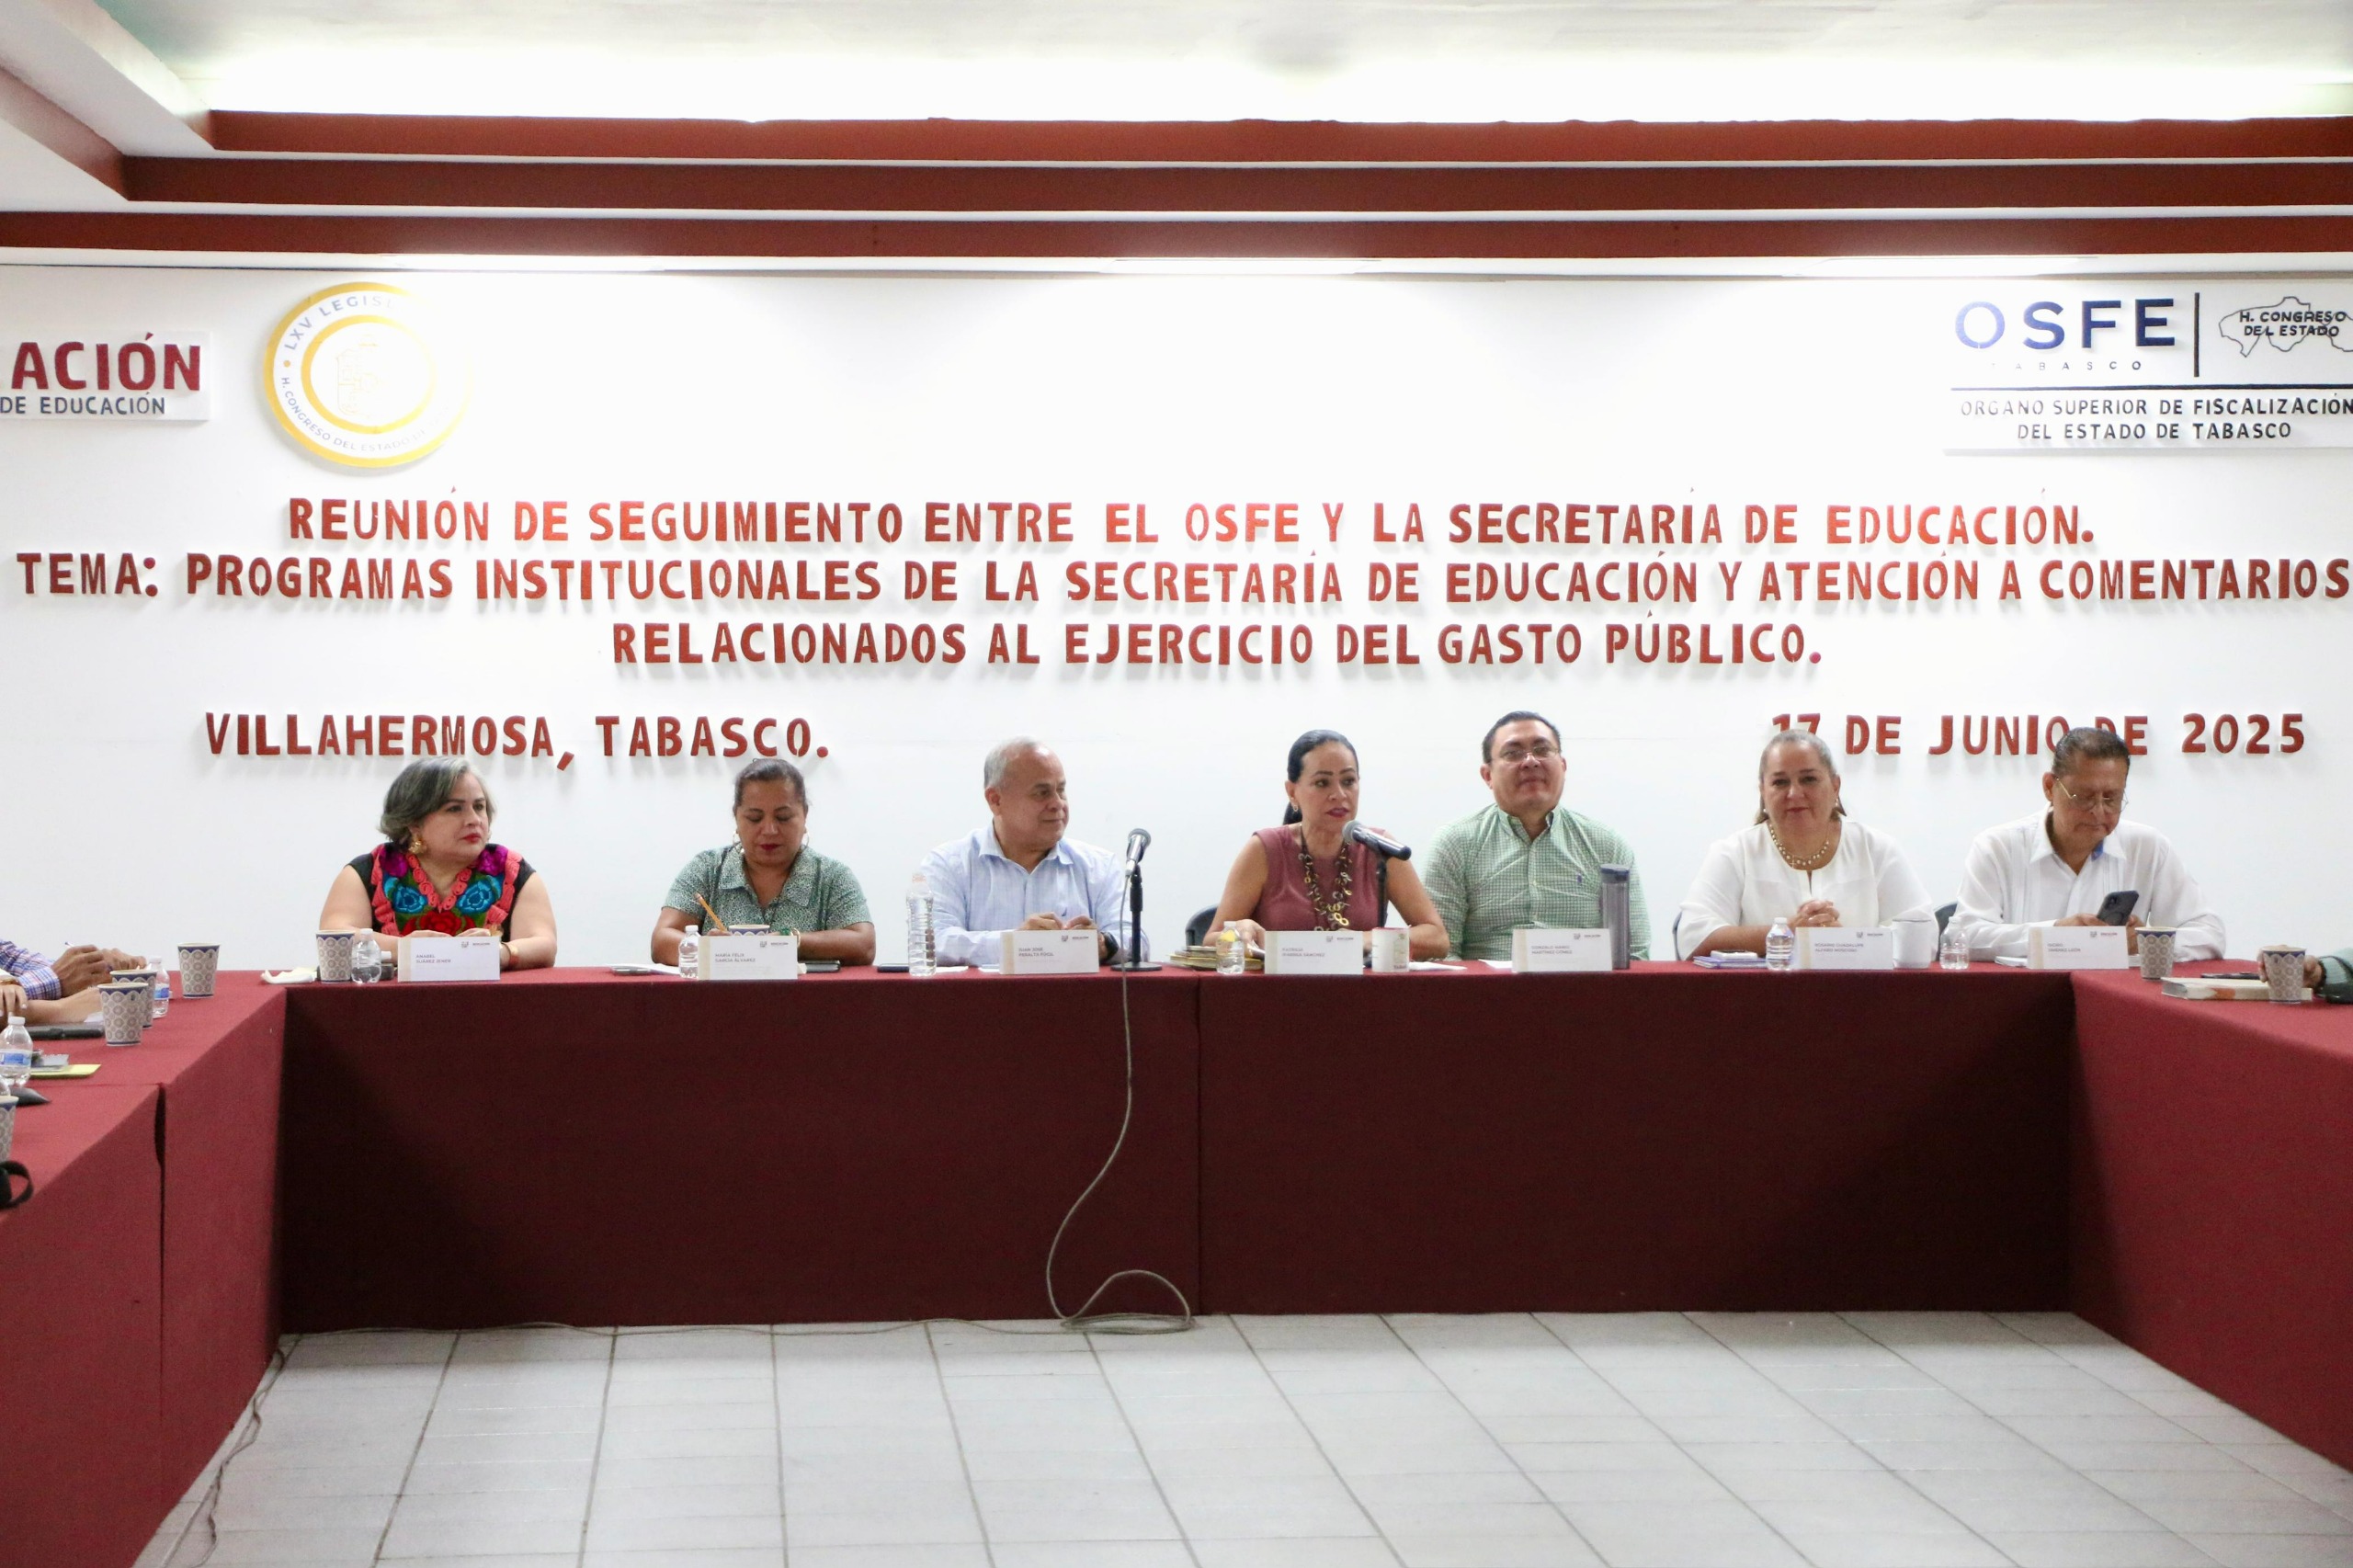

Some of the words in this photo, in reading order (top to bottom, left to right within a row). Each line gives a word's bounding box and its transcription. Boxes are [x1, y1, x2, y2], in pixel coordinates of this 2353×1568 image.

[284, 317, 313, 350] LXV
[1955, 298, 2175, 349] OSFE
[2239, 311, 2255, 323] H.
[2259, 311, 2347, 323] CONGRESO
[2244, 325, 2275, 336] DEL
[2279, 324, 2340, 337] ESTADO
[11, 332, 200, 391] ACIÓN
[0, 396, 26, 415] DE
[40, 392, 165, 415] EDUCACIÓN
[284, 391, 332, 441] CONGRESO
[333, 437, 358, 450] DEL
[2052, 399, 2148, 415] SUPERIOR
[2159, 398, 2183, 415] DE
[2017, 423, 2052, 440] DEL
[2063, 423, 2146, 439] ESTADO
[2155, 423, 2180, 439] DE
[2192, 422, 2291, 439] TABASCO
[290, 486, 489, 541] REUNIÓN
[515, 501, 568, 541] DE
[589, 501, 902, 542] SEGUIMIENTO
[926, 502, 1073, 542] ENTRE
[1106, 503, 1158, 543] EL
[1185, 503, 1299, 543] OSFE
[1323, 503, 1344, 542] Y
[1374, 503, 1424, 542] LA
[1449, 487, 1722, 544] SECRETARÍA
[1745, 504, 1798, 544] DE
[1827, 487, 2094, 544] EDUCACIÓN.
[17, 552, 159, 597] TEMA:
[188, 554, 453, 599] PROGRAMAS
[477, 559, 881, 600] INSTITUCIONALES
[905, 561, 957, 601] DE
[986, 562, 1039, 601] LA
[1067, 550, 1342, 604] SECRETARÍA
[1369, 562, 1418, 602] DE
[1447, 551, 1698, 603] EDUCACIÓN
[1720, 562, 1742, 600] Y
[1760, 551, 1979, 600] ATENCIÓN
[1999, 561, 2021, 600] A
[2040, 558, 2349, 600] COMENTARIOS
[613, 622, 966, 664] RELACIONADOS
[988, 624, 1040, 664] AL
[1066, 624, 1313, 665] EJERCICIO
[1337, 624, 1420, 665] DEL
[1438, 623, 1581, 665] GASTO
[1607, 609, 1821, 665] PÚBLICO.
[206, 712, 574, 770] VILLAHERMOSA,
[596, 716, 829, 757] TABASCO.
[1846, 715, 1901, 755] DE
[1928, 715, 2070, 756] JUNIO
[2183, 713, 2305, 754] 2025
